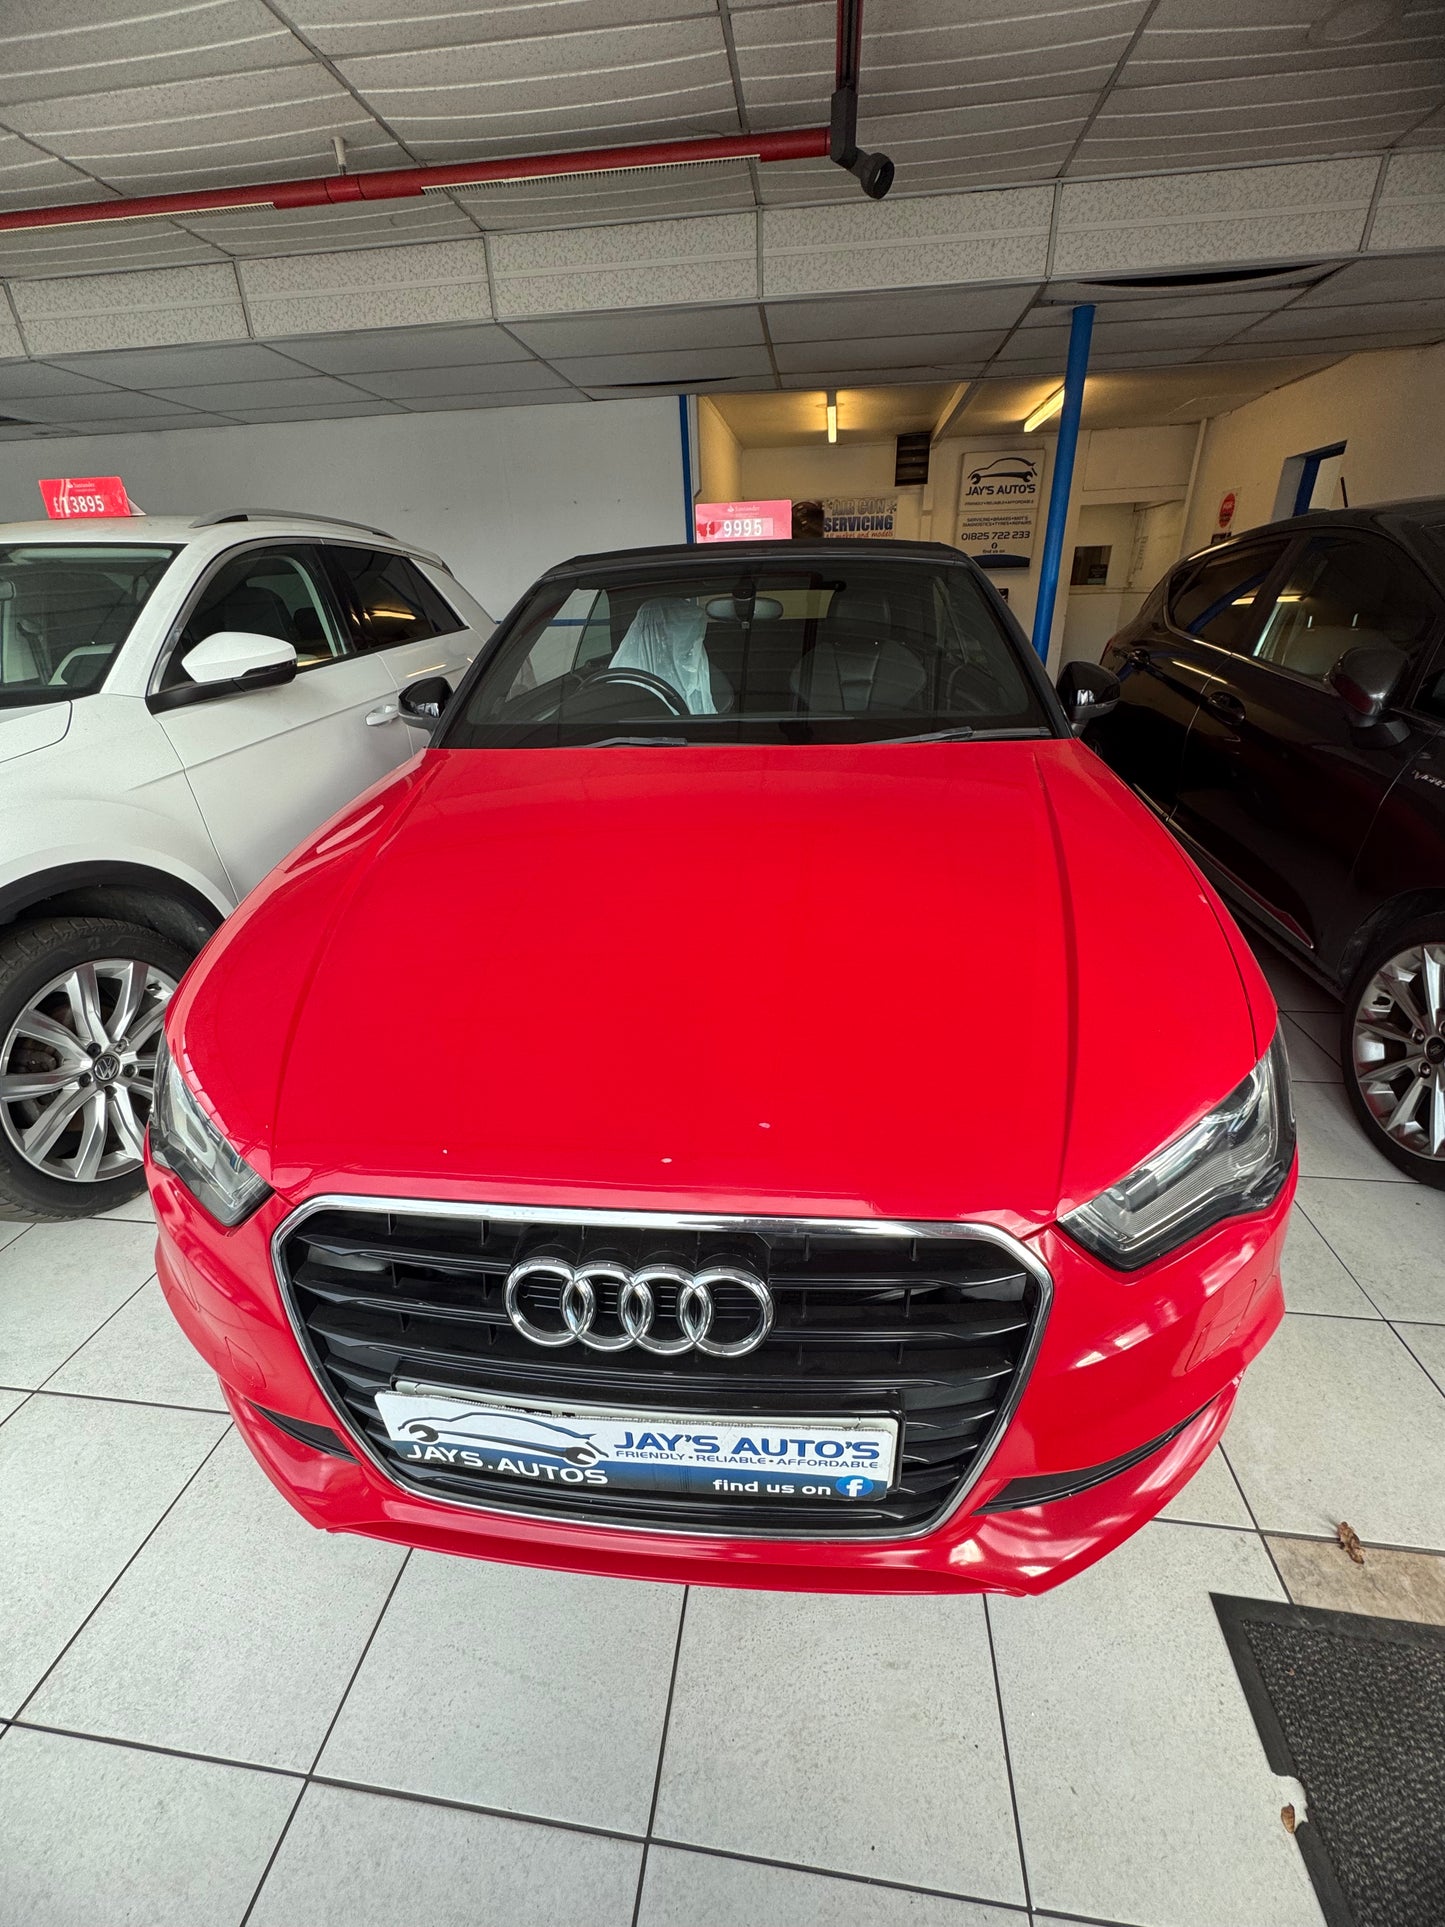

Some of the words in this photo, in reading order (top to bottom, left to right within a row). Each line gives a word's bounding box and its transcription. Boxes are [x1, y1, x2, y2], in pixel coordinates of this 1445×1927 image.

[965, 486, 995, 496] JAY'S
[997, 484, 1036, 494] AUTO'S
[832, 498, 855, 515] AIR
[857, 498, 885, 514] CON
[723, 519, 763, 538] 9995
[823, 515, 893, 532] SERVICING
[961, 532, 990, 541] 01825
[992, 531, 1010, 540] 722
[1012, 530, 1031, 539] 233
[614, 1431, 720, 1453] JAY'S
[731, 1437, 880, 1460] AUTO'S
[615, 1450, 685, 1461] FRIENDLY
[696, 1454, 766, 1465] RELIABLE
[777, 1458, 878, 1469] AFFORDABLE
[712, 1479, 758, 1493] find
[767, 1483, 795, 1494] us
[801, 1484, 831, 1495] on
